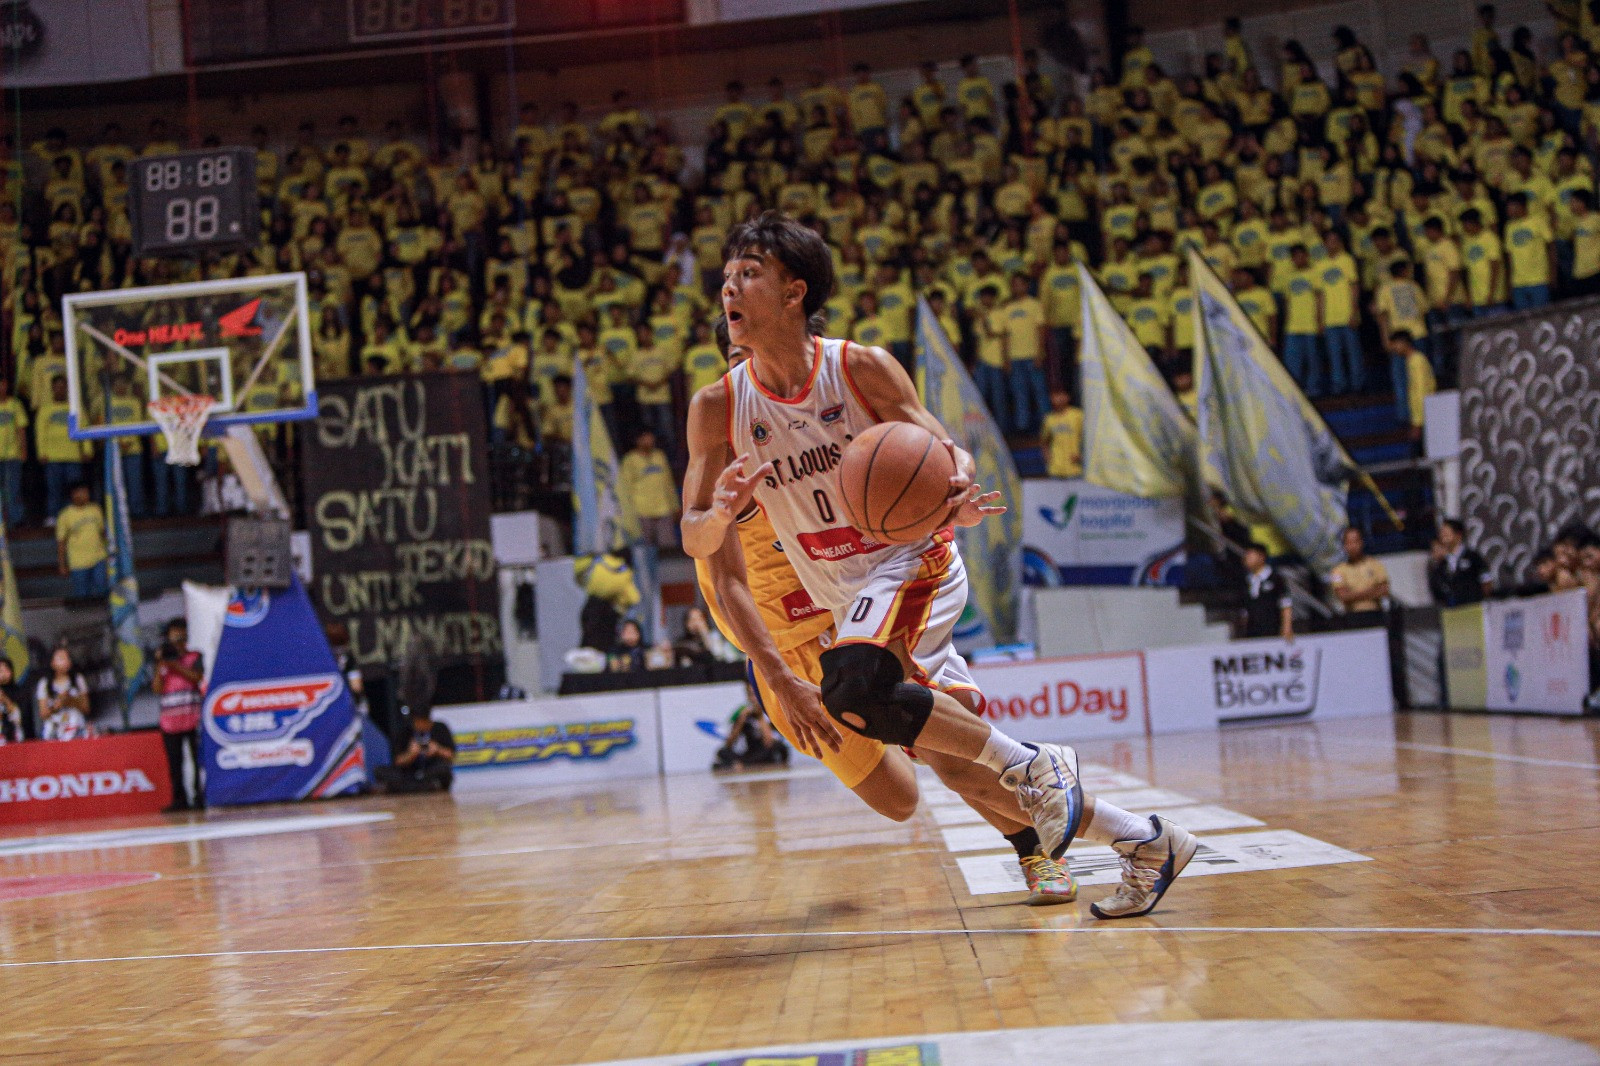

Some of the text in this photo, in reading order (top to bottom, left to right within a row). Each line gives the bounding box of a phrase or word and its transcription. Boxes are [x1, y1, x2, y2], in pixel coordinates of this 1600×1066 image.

[317, 380, 426, 449] SATU
[315, 487, 438, 552] SATU
[813, 489, 837, 524] 0
[791, 606, 811, 618] One
[851, 597, 874, 622] 0
[984, 681, 1128, 721] ood Day
[1216, 677, 1306, 708] Bioré
[0, 768, 156, 803] HONDA
